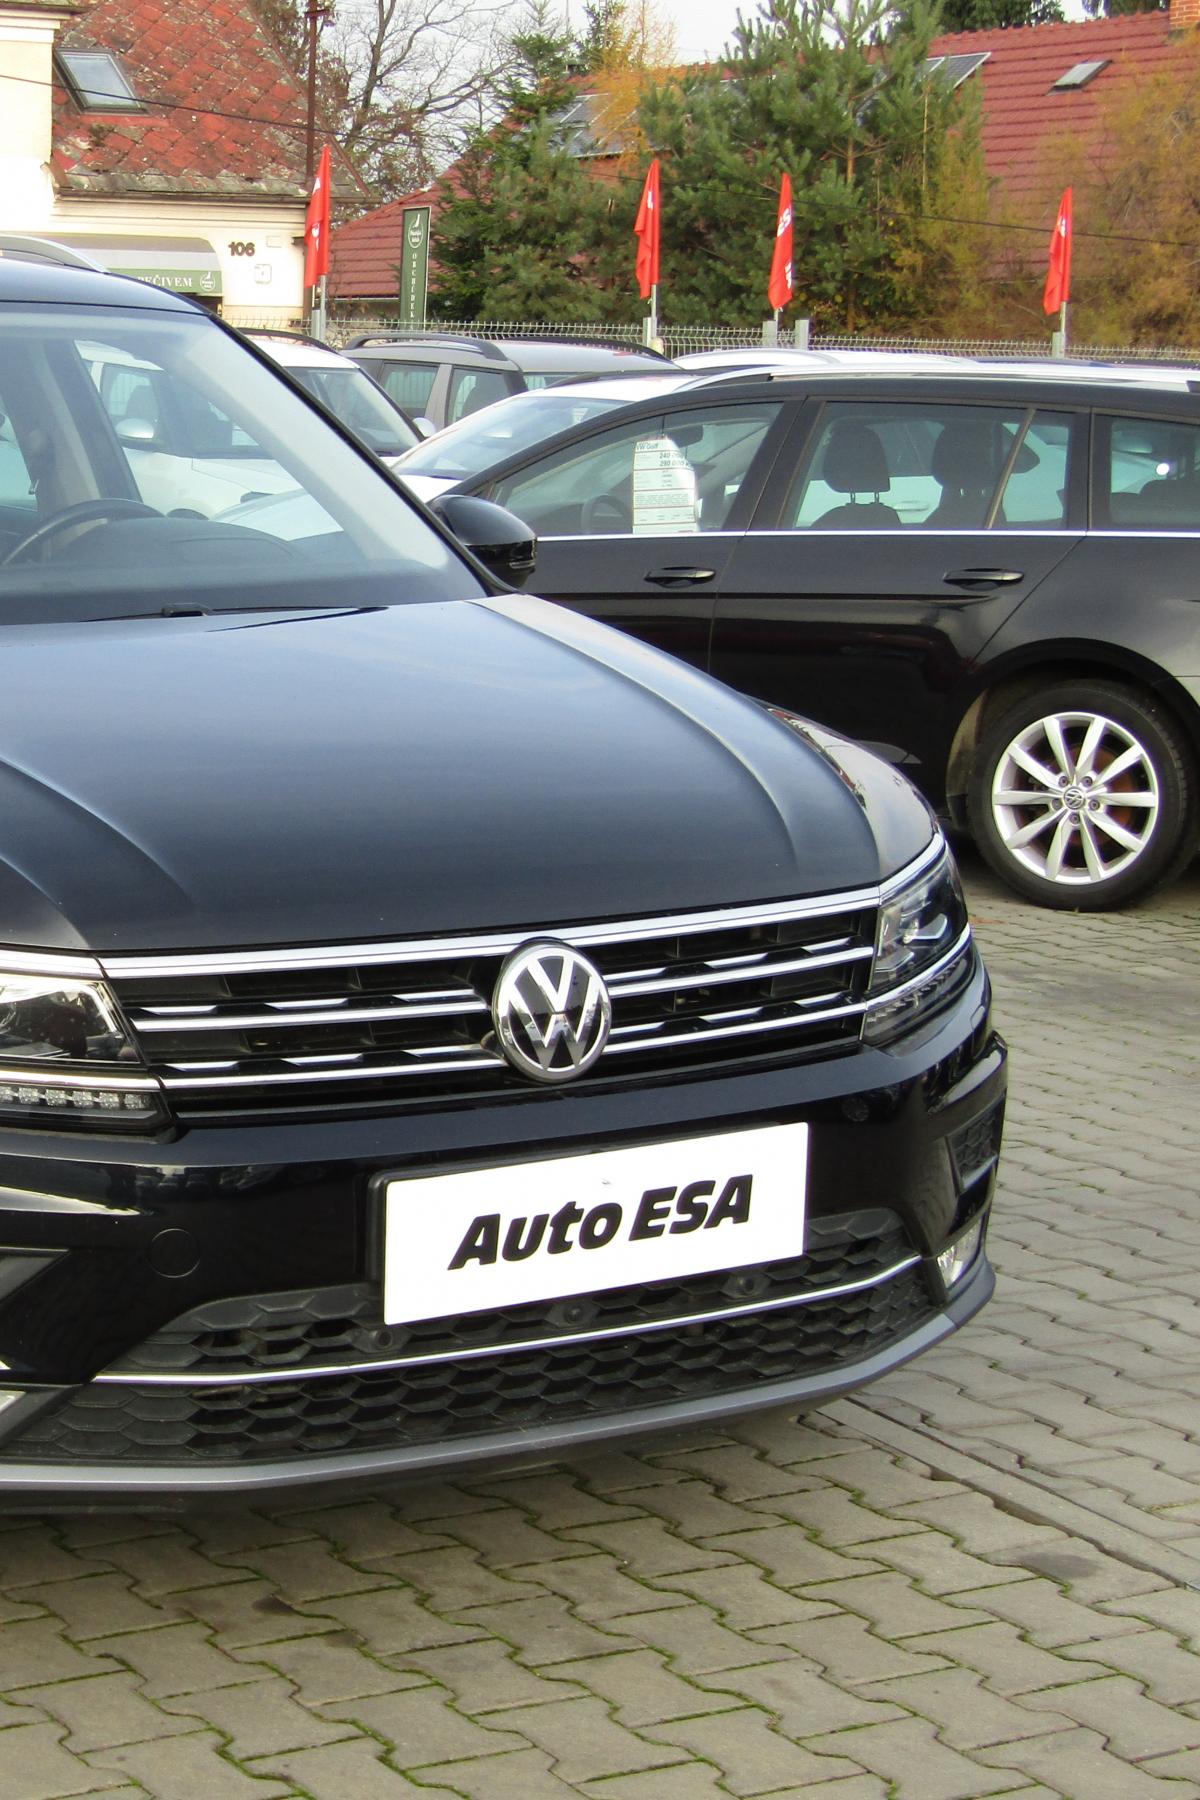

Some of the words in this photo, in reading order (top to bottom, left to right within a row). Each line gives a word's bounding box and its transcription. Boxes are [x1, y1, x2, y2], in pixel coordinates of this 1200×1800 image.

[228, 241, 255, 257] 106
[447, 1201, 623, 1271] Auto
[628, 1174, 753, 1241] ESA
